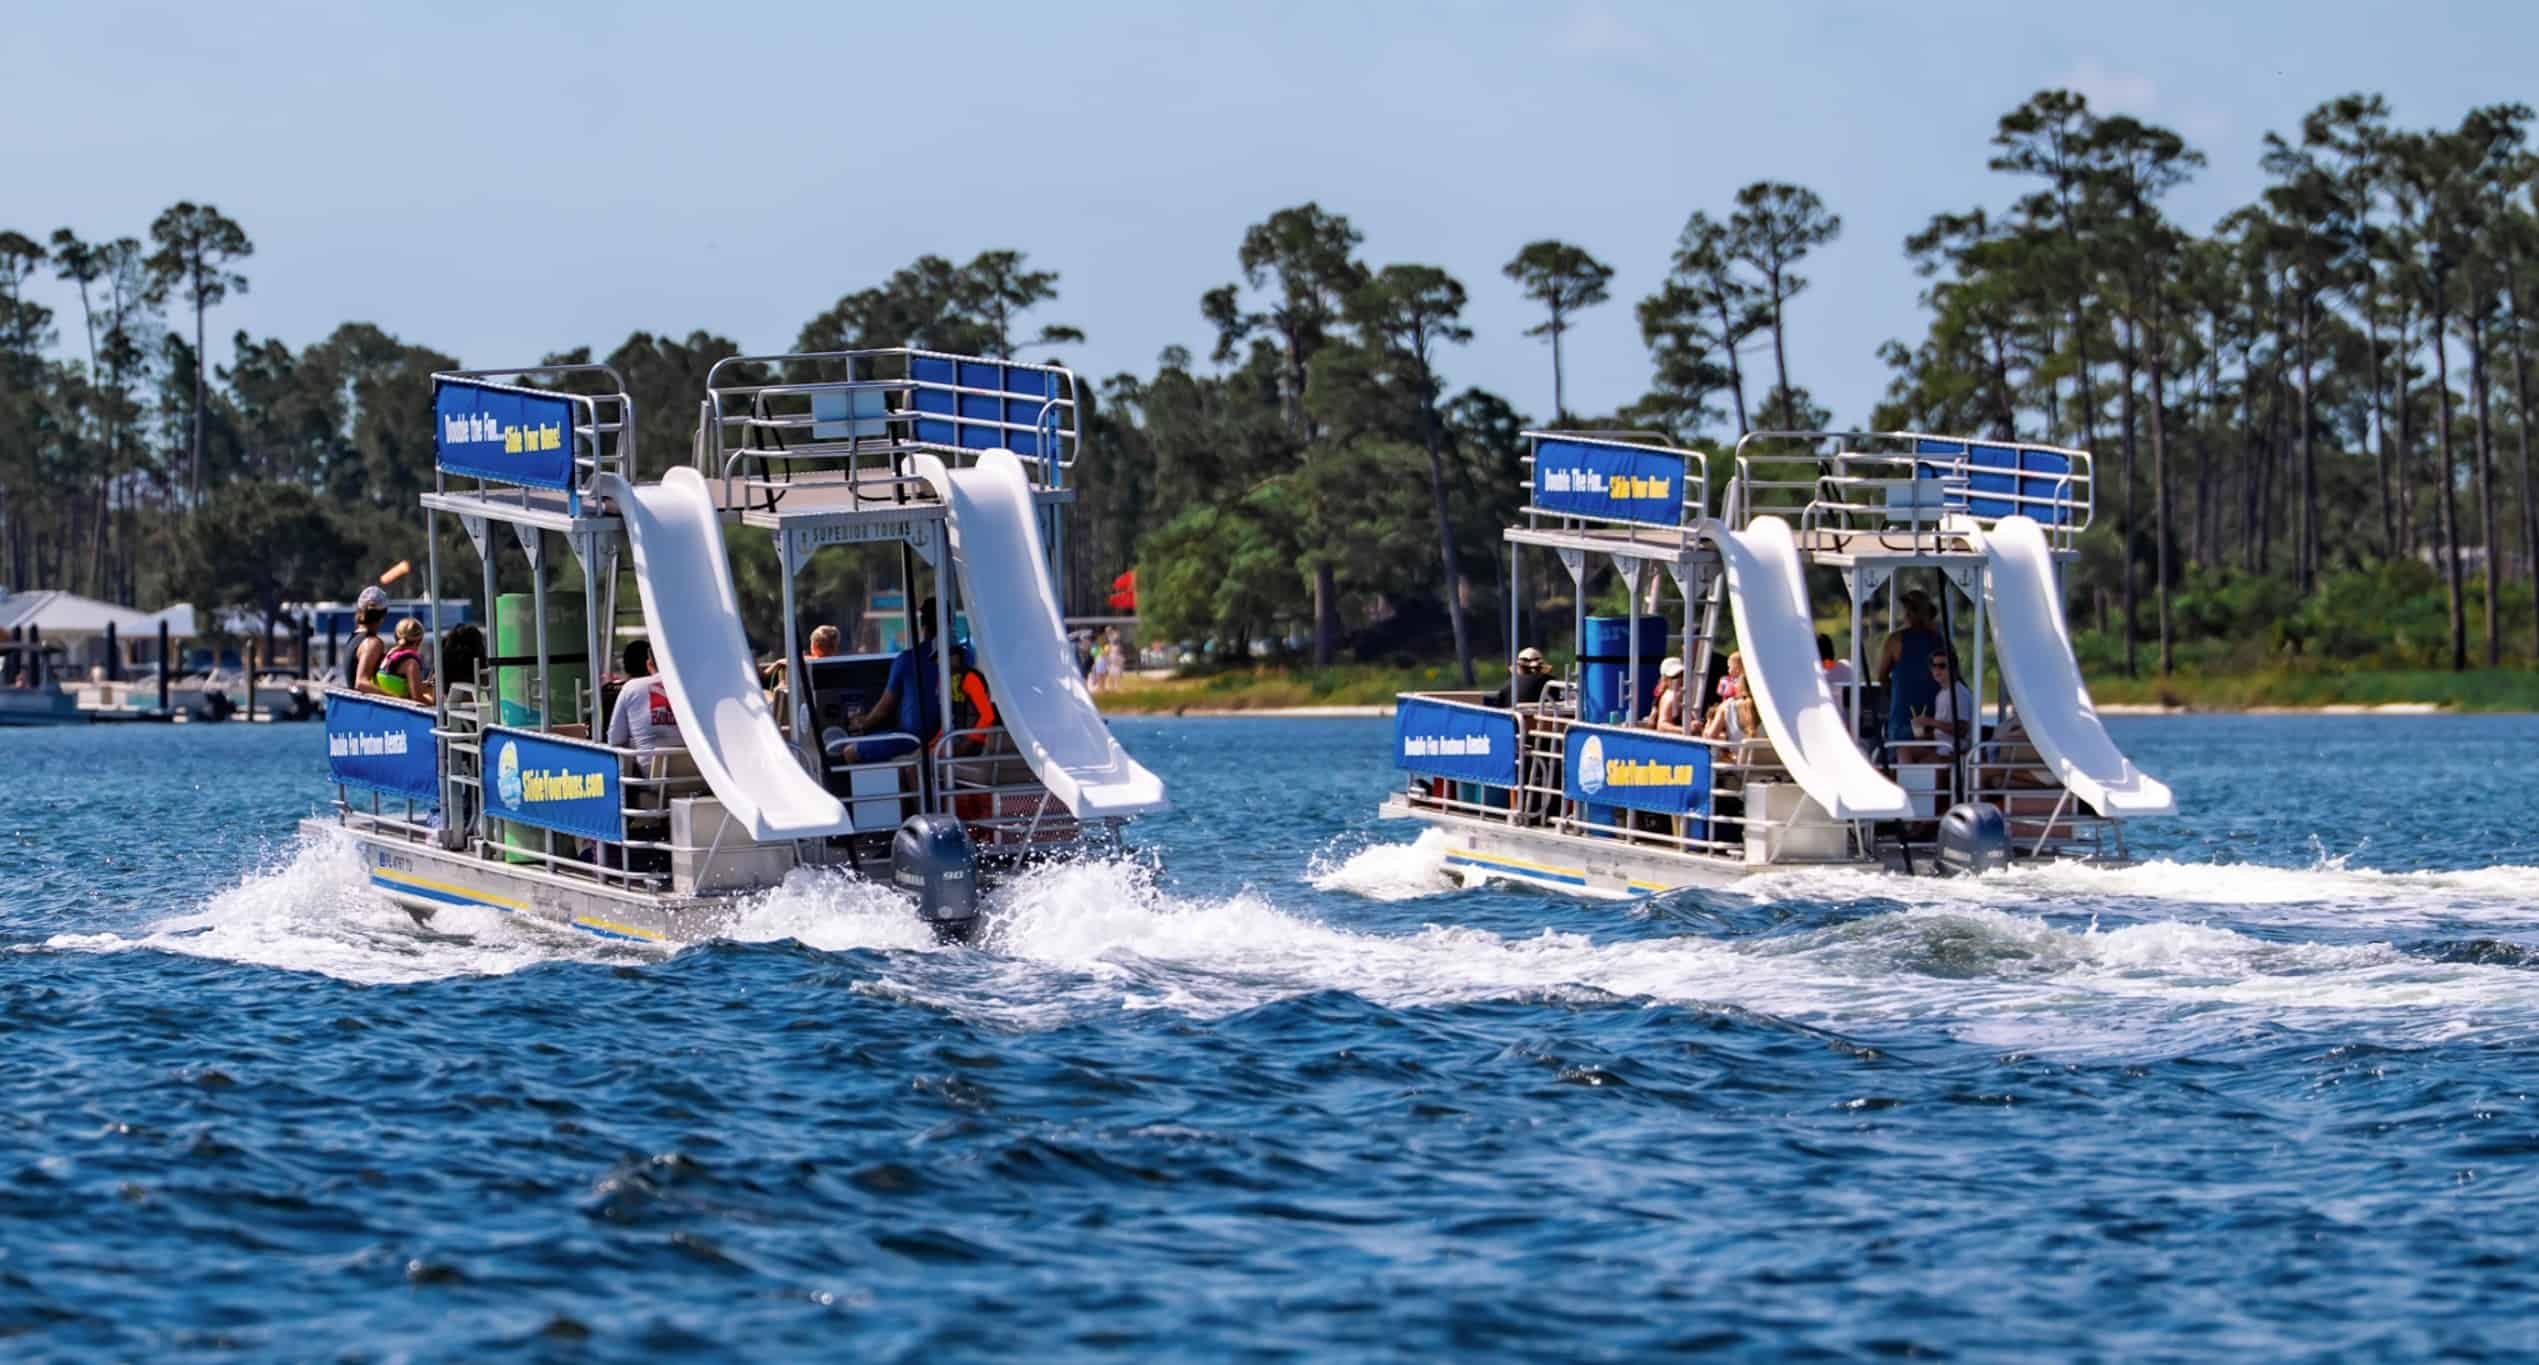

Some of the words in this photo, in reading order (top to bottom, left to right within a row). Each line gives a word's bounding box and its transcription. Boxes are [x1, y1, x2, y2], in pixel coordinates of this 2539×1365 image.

[444, 413, 469, 444] Double
[504, 425, 522, 454] Slide
[523, 424, 539, 452] Your
[540, 421, 561, 450] Buns!
[1544, 467, 1571, 492] Double
[1571, 467, 1586, 492] The
[1609, 475, 1630, 499] Slide
[813, 524, 868, 542] SUPERIOR
[876, 520, 910, 537] TOURS
[329, 732, 348, 757] Double
[348, 731, 360, 756] Fun
[360, 731, 383, 756] Pontoon
[384, 729, 407, 755] Rentals
[1404, 735, 1426, 757] Double
[1427, 735, 1439, 756] Fun
[1465, 733, 1490, 755] Rentals
[522, 768, 605, 803] SlideYourBuns.com
[943, 870, 965, 880] 90
